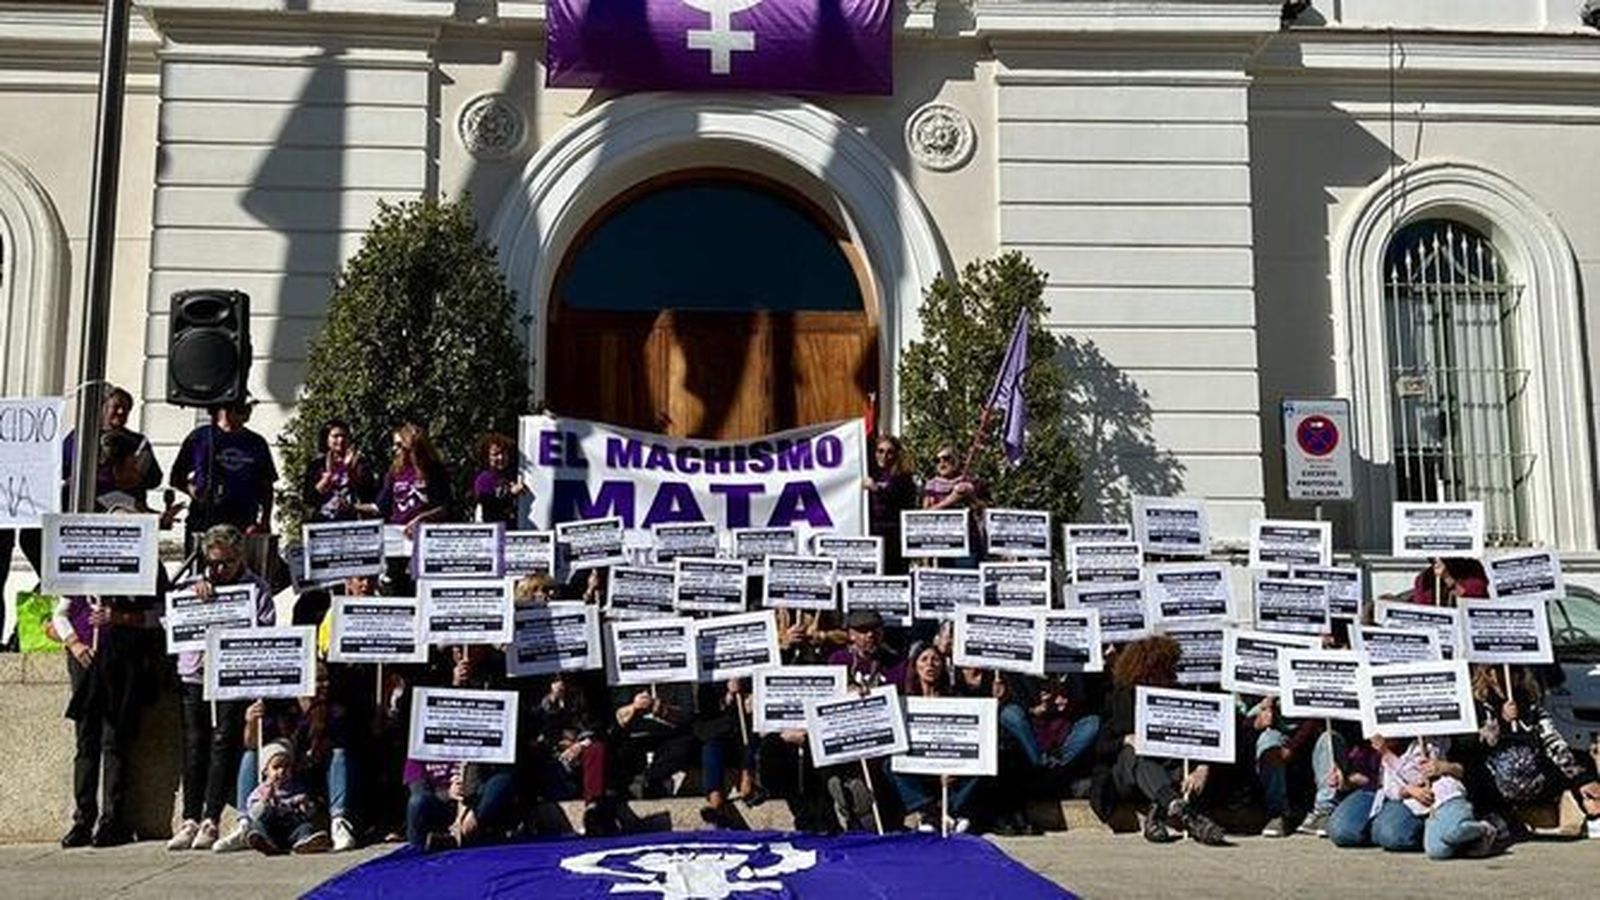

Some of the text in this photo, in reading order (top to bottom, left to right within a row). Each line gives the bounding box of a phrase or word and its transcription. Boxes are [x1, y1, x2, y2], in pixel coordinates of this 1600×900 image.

[538, 430, 843, 475] EL MACHISMO
[551, 480, 834, 529] MATA
